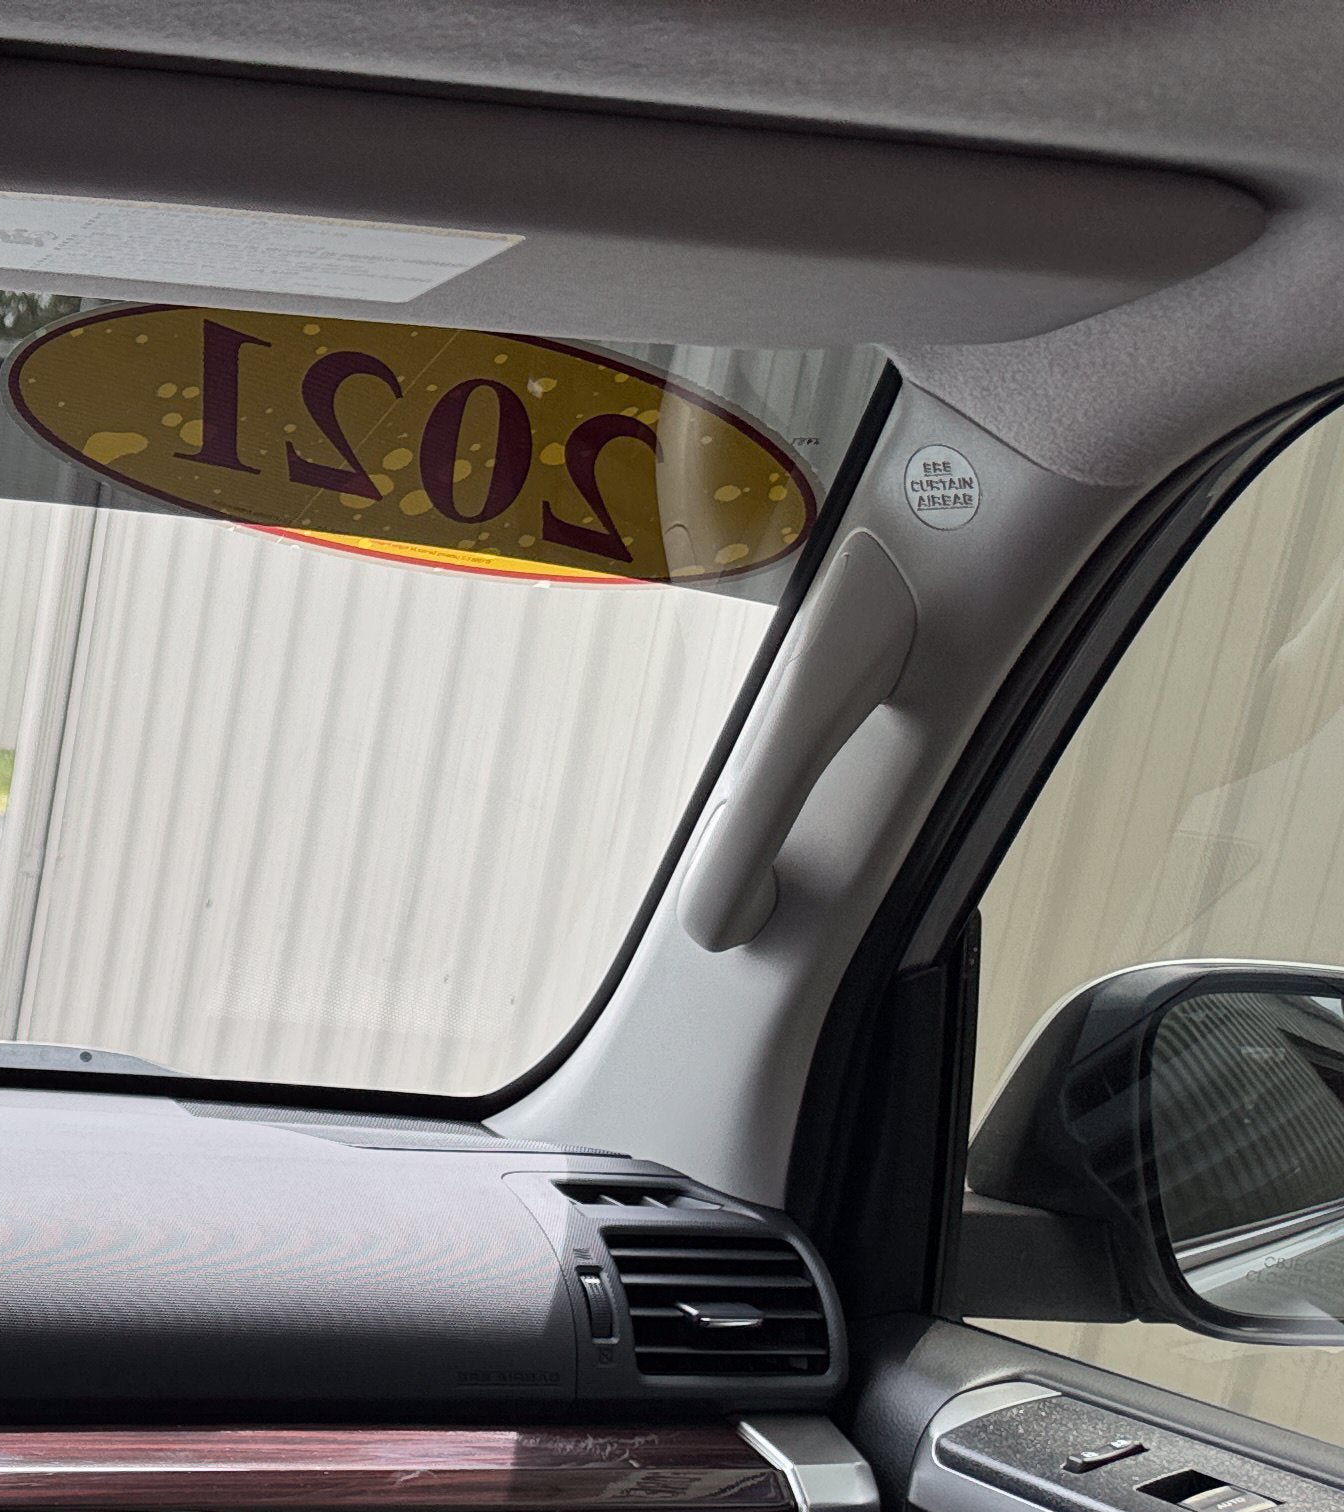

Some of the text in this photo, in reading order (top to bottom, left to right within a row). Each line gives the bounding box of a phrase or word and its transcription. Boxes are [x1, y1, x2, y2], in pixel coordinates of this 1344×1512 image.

[910, 476, 974, 493] CURTAIN
[916, 493, 974, 508] AIRBAG
[1216, 1496, 1247, 1510] AUTO
